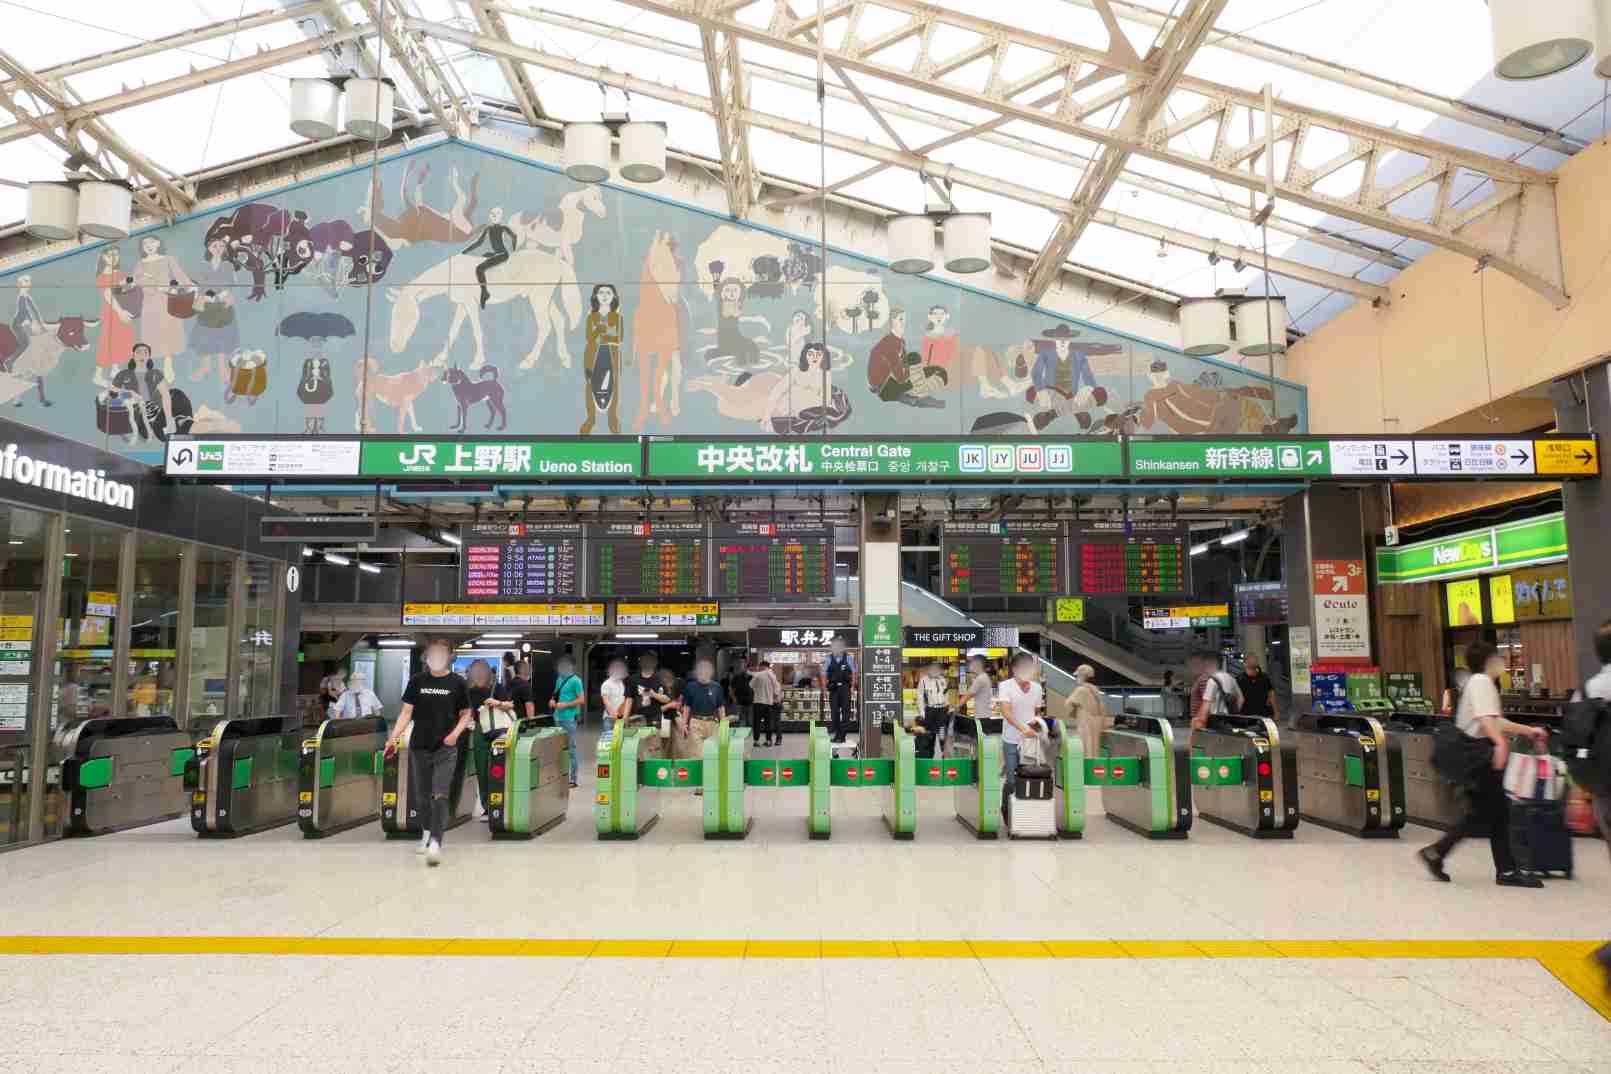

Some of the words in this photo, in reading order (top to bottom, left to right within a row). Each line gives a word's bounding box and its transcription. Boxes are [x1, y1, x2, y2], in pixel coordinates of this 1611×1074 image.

[399, 445, 437, 465] JR
[445, 444, 532, 472] 上野駅
[698, 445, 813, 473] 中央改札
[821, 444, 873, 457] Central
[877, 444, 912, 457] Gate
[966, 453, 980, 464] JK
[994, 453, 1008, 464] JY
[1024, 453, 1038, 464] JU
[1205, 447, 1274, 470] 新幹線
[540, 460, 577, 474] Ueno
[581, 460, 633, 474] Station
[1135, 459, 1200, 470] Shinkansen
[0, 443, 135, 510] formation
[913, 633, 931, 641] THE
[933, 633, 951, 641] GIFT
[953, 633, 976, 641] SHOP
